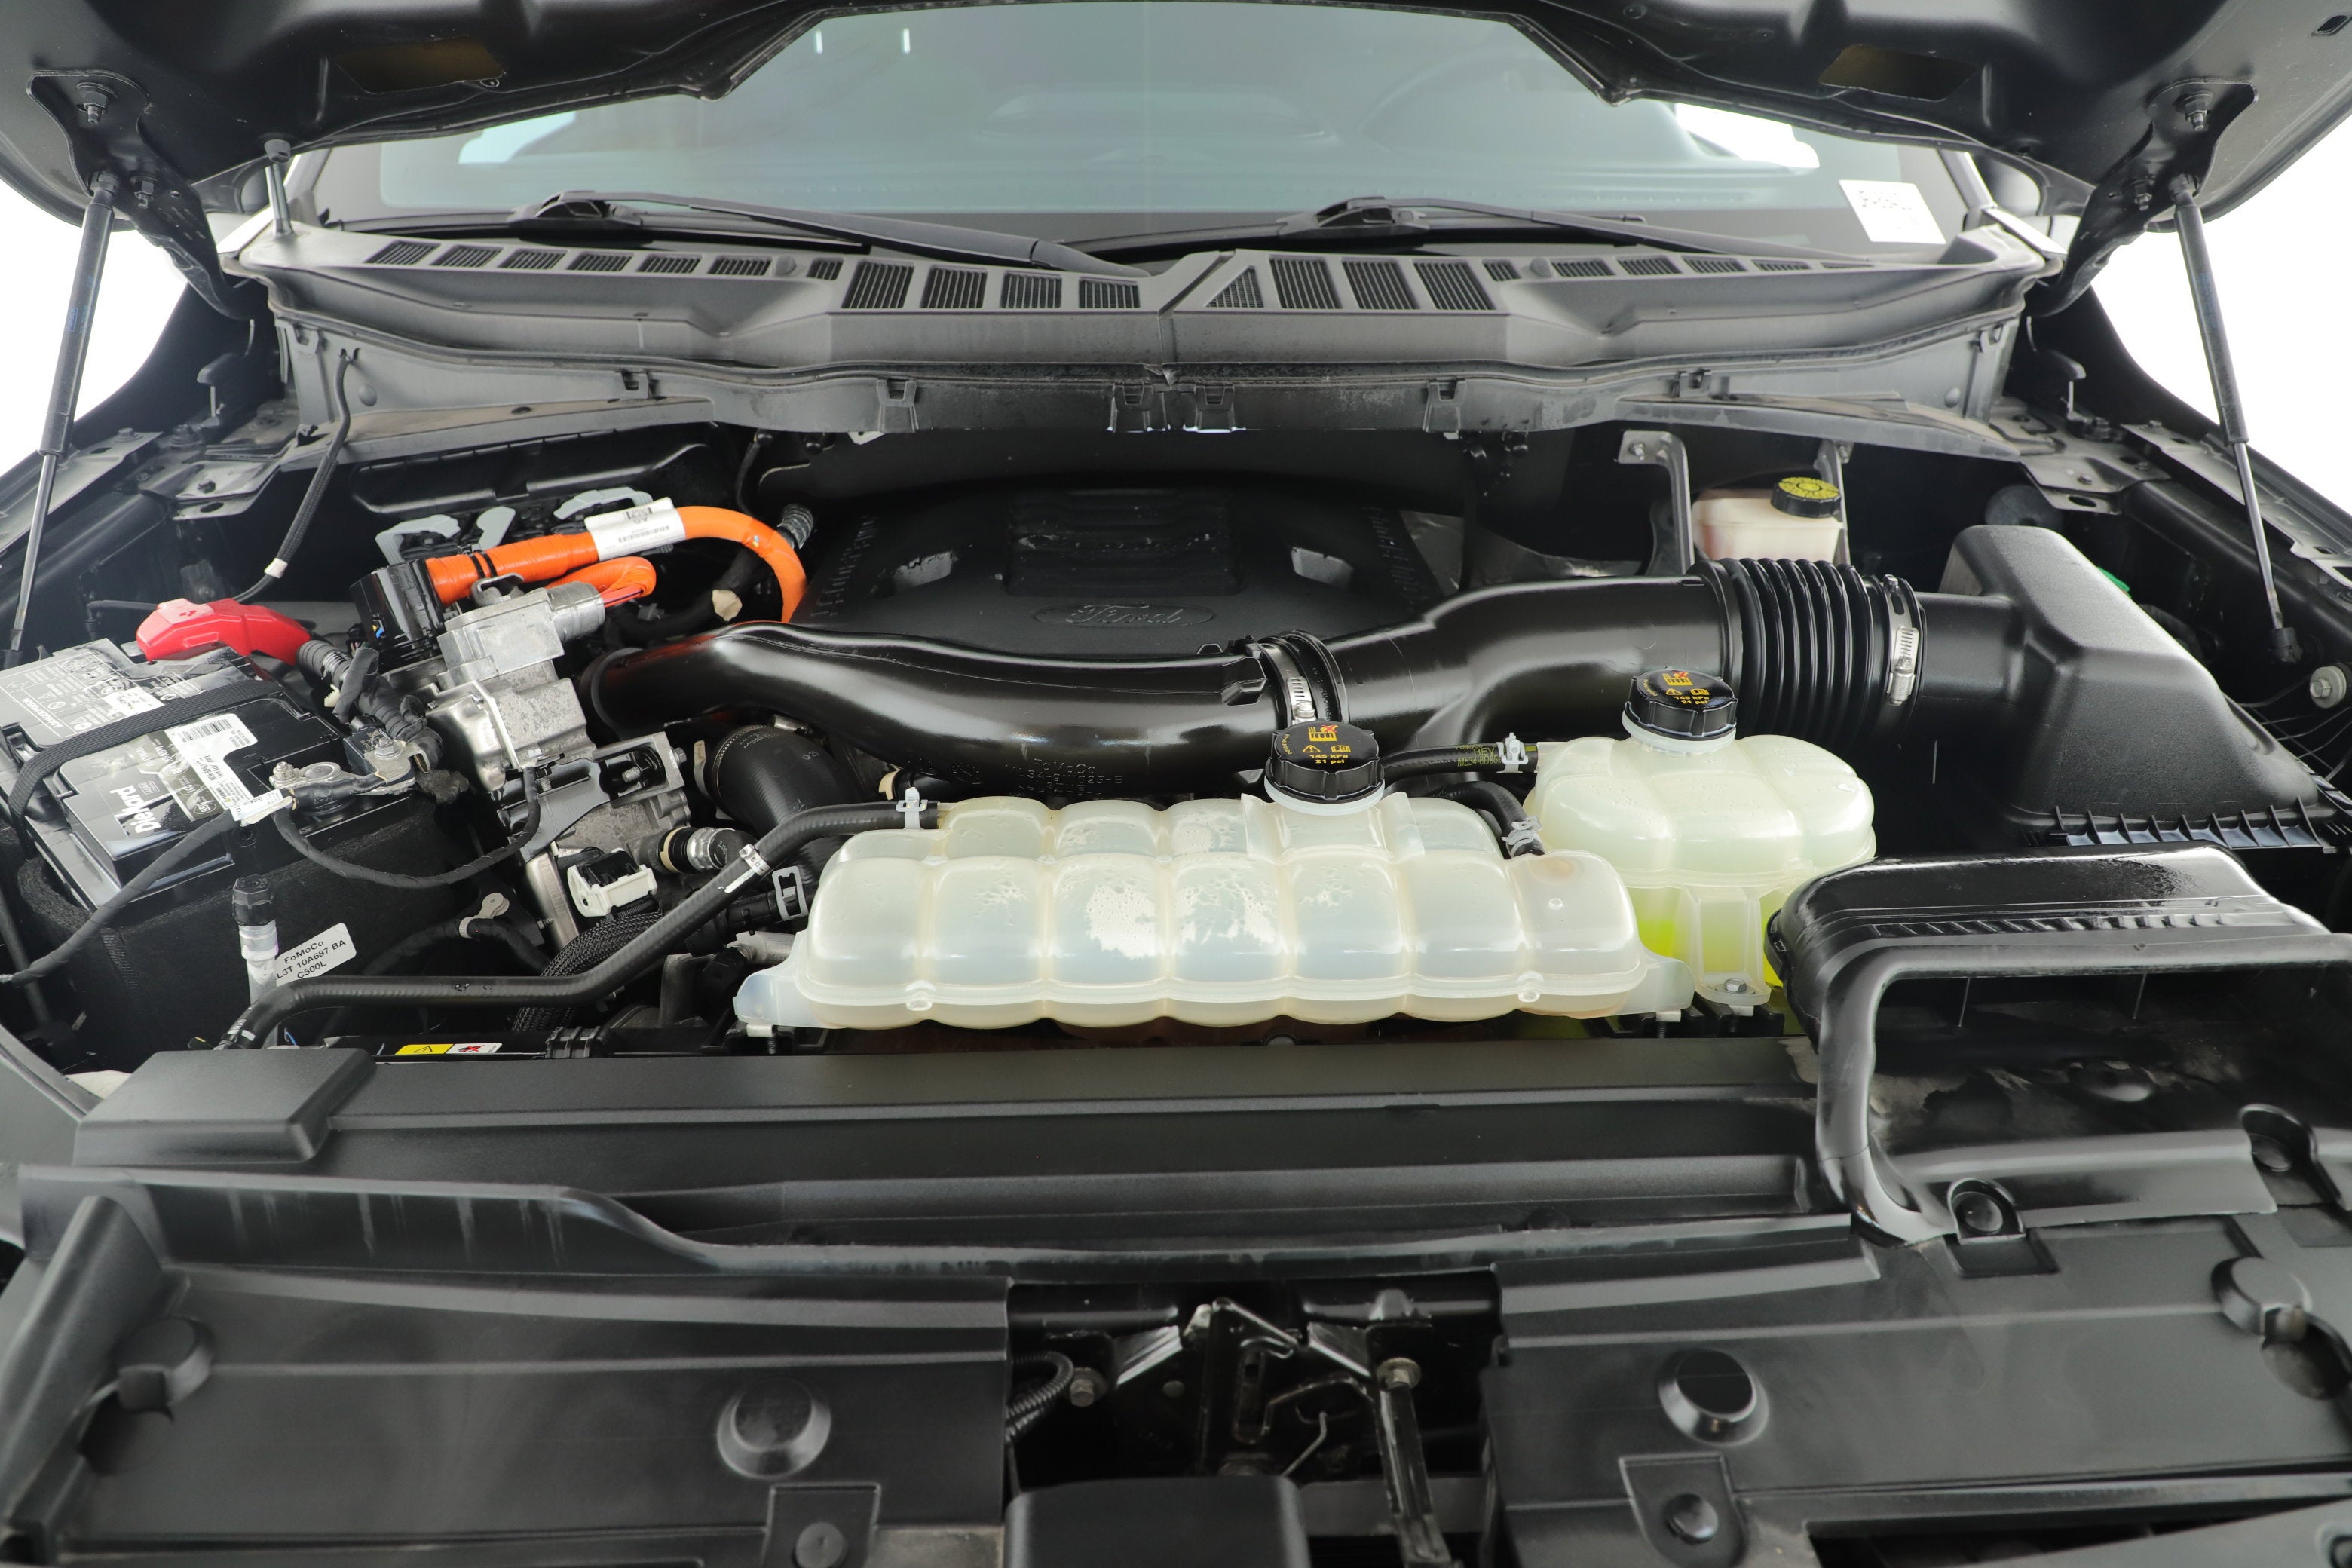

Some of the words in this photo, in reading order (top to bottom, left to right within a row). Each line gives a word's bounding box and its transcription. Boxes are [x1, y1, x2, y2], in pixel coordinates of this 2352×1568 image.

[1064, 603, 1184, 624] Ford
[1473, 747, 1495, 756] HEV
[110, 786, 161, 834] DieHard
[284, 941, 324, 964] FoMoCo
[297, 947, 329, 968] 10A687
[332, 939, 347, 951] BA
[297, 961, 327, 979] C500L
